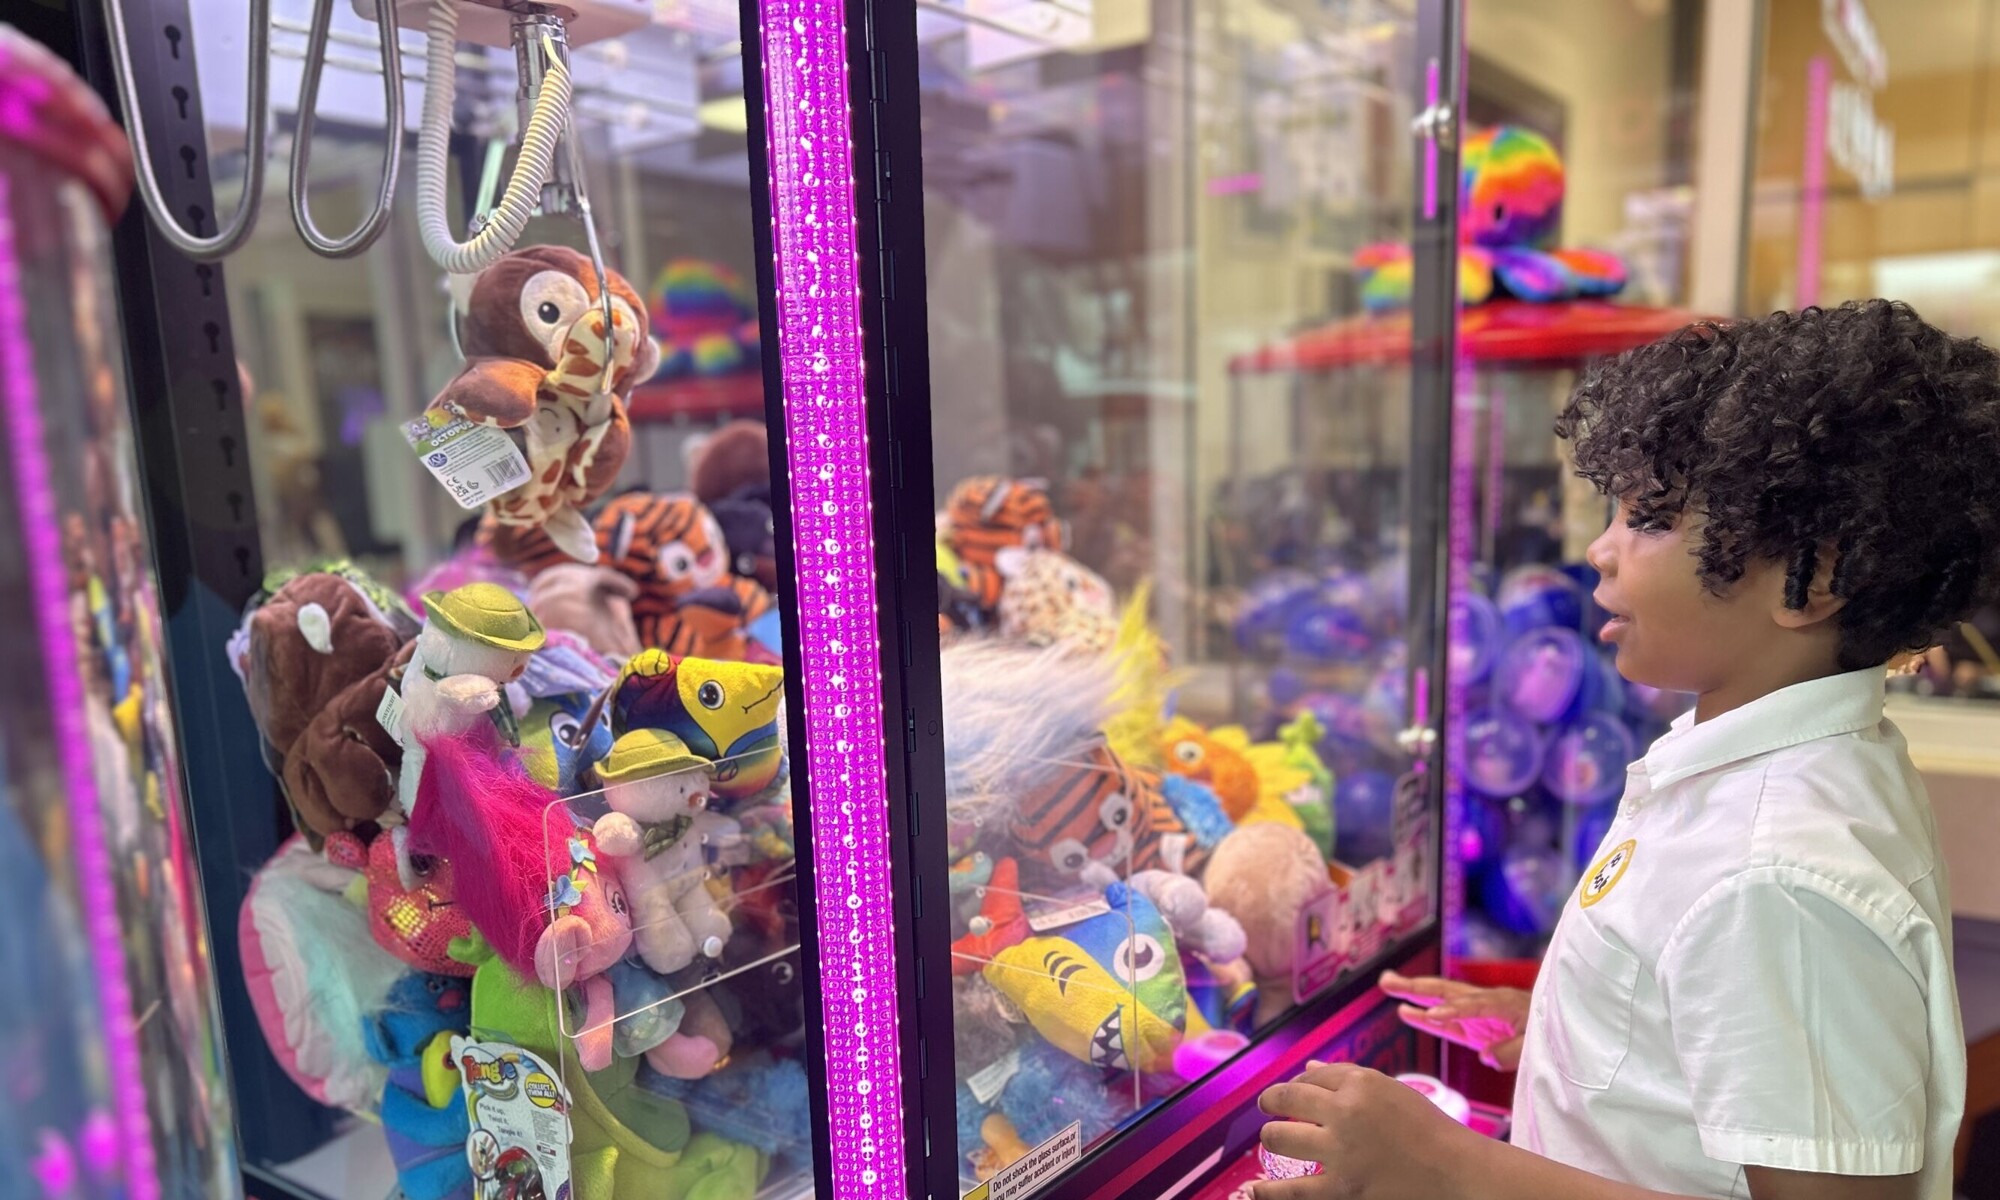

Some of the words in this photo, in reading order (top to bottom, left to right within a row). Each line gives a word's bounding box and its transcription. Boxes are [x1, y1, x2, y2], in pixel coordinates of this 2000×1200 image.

[430, 419, 475, 447] OCTOPUS
[462, 1056, 517, 1085] Tangle
[993, 1182, 1001, 1192] Do
[1002, 1173, 1011, 1186] not
[1012, 1162, 1028, 1180] shock
[1028, 1157, 1037, 1169] the
[1038, 1148, 1051, 1164] glass
[1006, 1184, 1017, 1198] may
[1018, 1172, 1033, 1189] suffer
[1034, 1159, 1055, 1179] accident
[1061, 1145, 1076, 1160] injury
